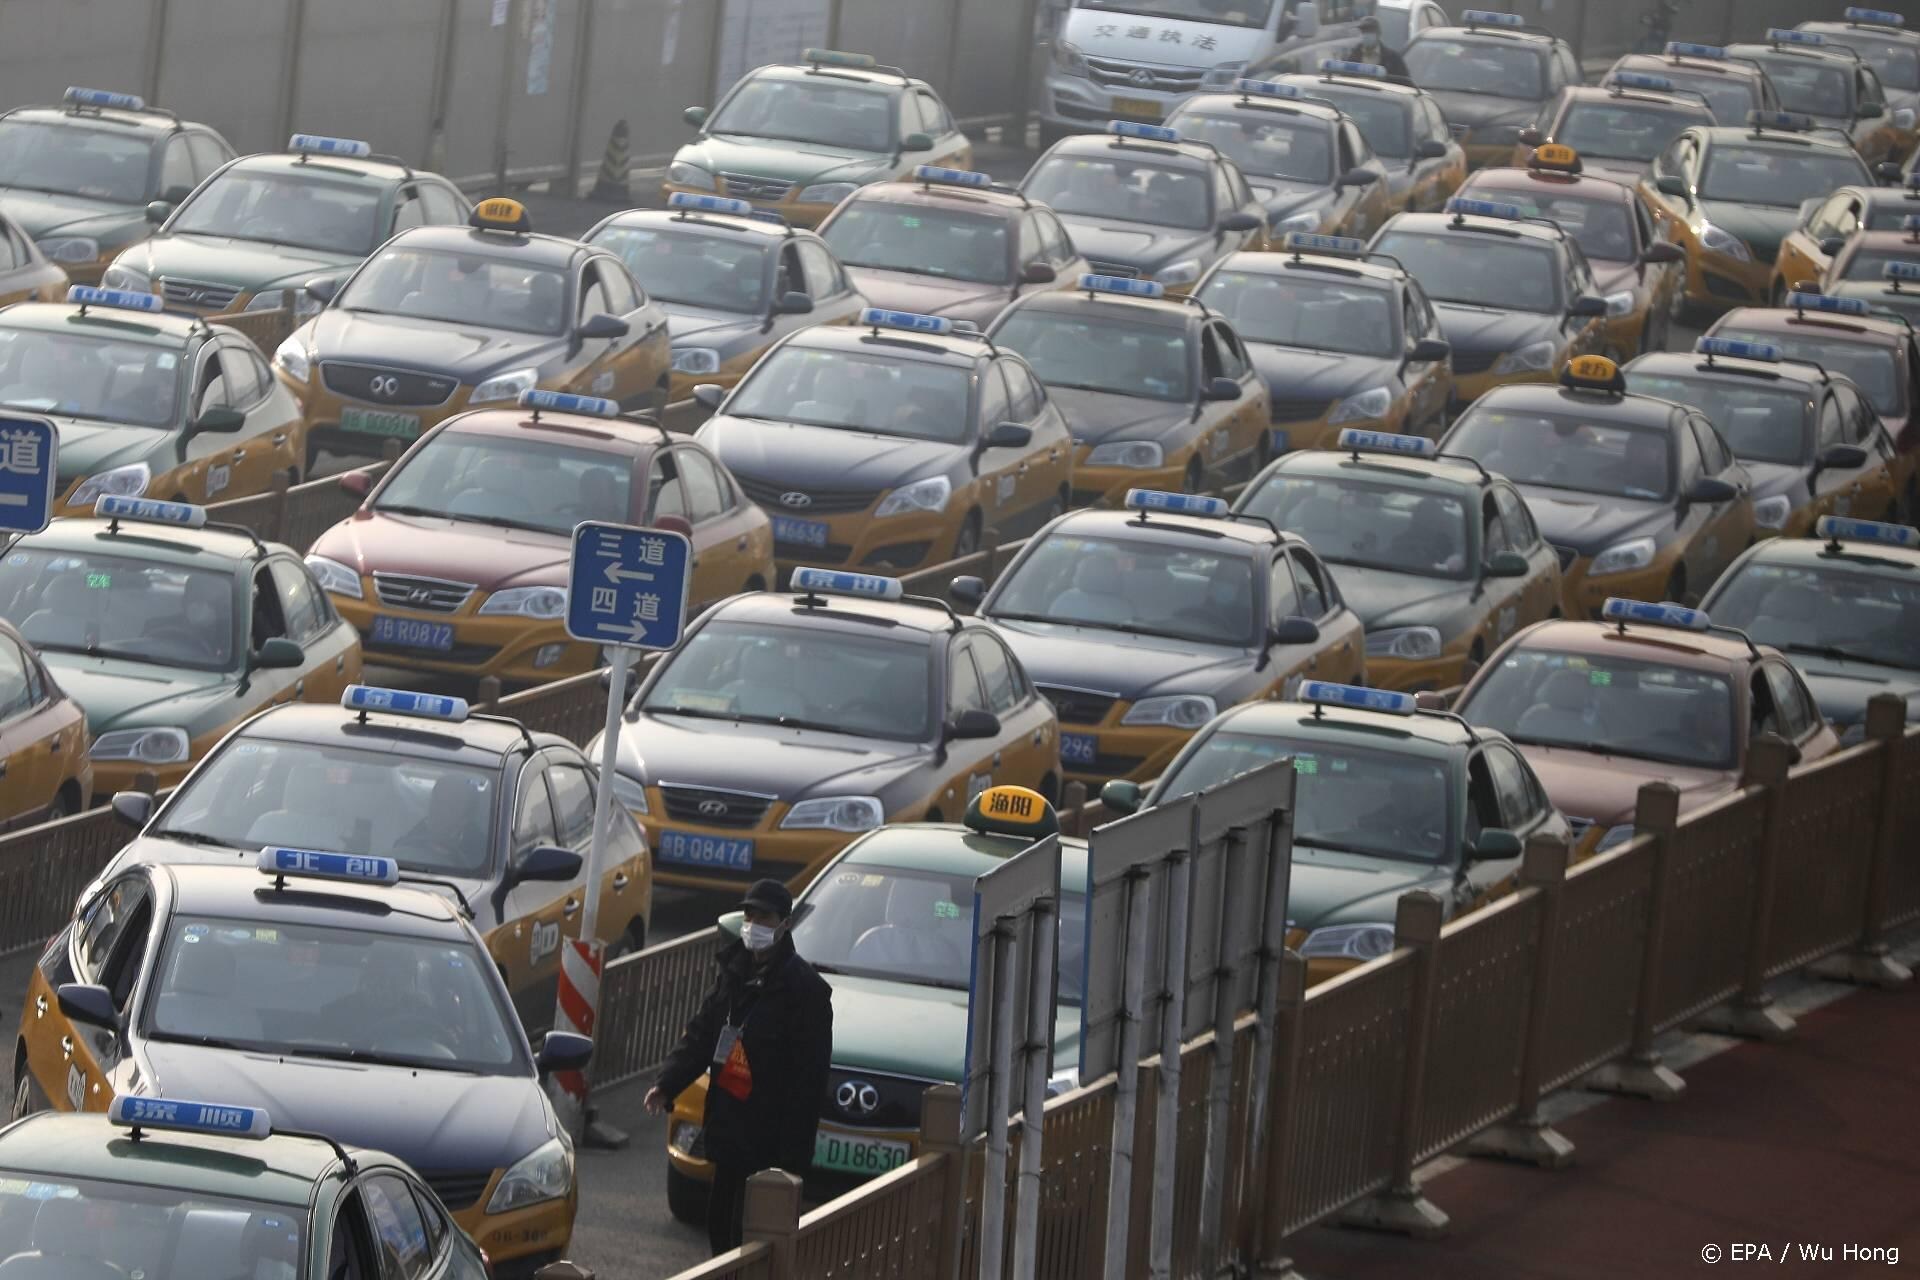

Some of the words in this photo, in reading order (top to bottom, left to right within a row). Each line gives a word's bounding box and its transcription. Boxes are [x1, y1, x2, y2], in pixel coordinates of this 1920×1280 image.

[1092, 24, 1217, 51] 交通执法
[0, 428, 42, 474] 道
[596, 532, 666, 566] 三道
[591, 586, 661, 621] 四道
[989, 791, 1033, 817] 渔阳
[285, 850, 380, 878] 北创
